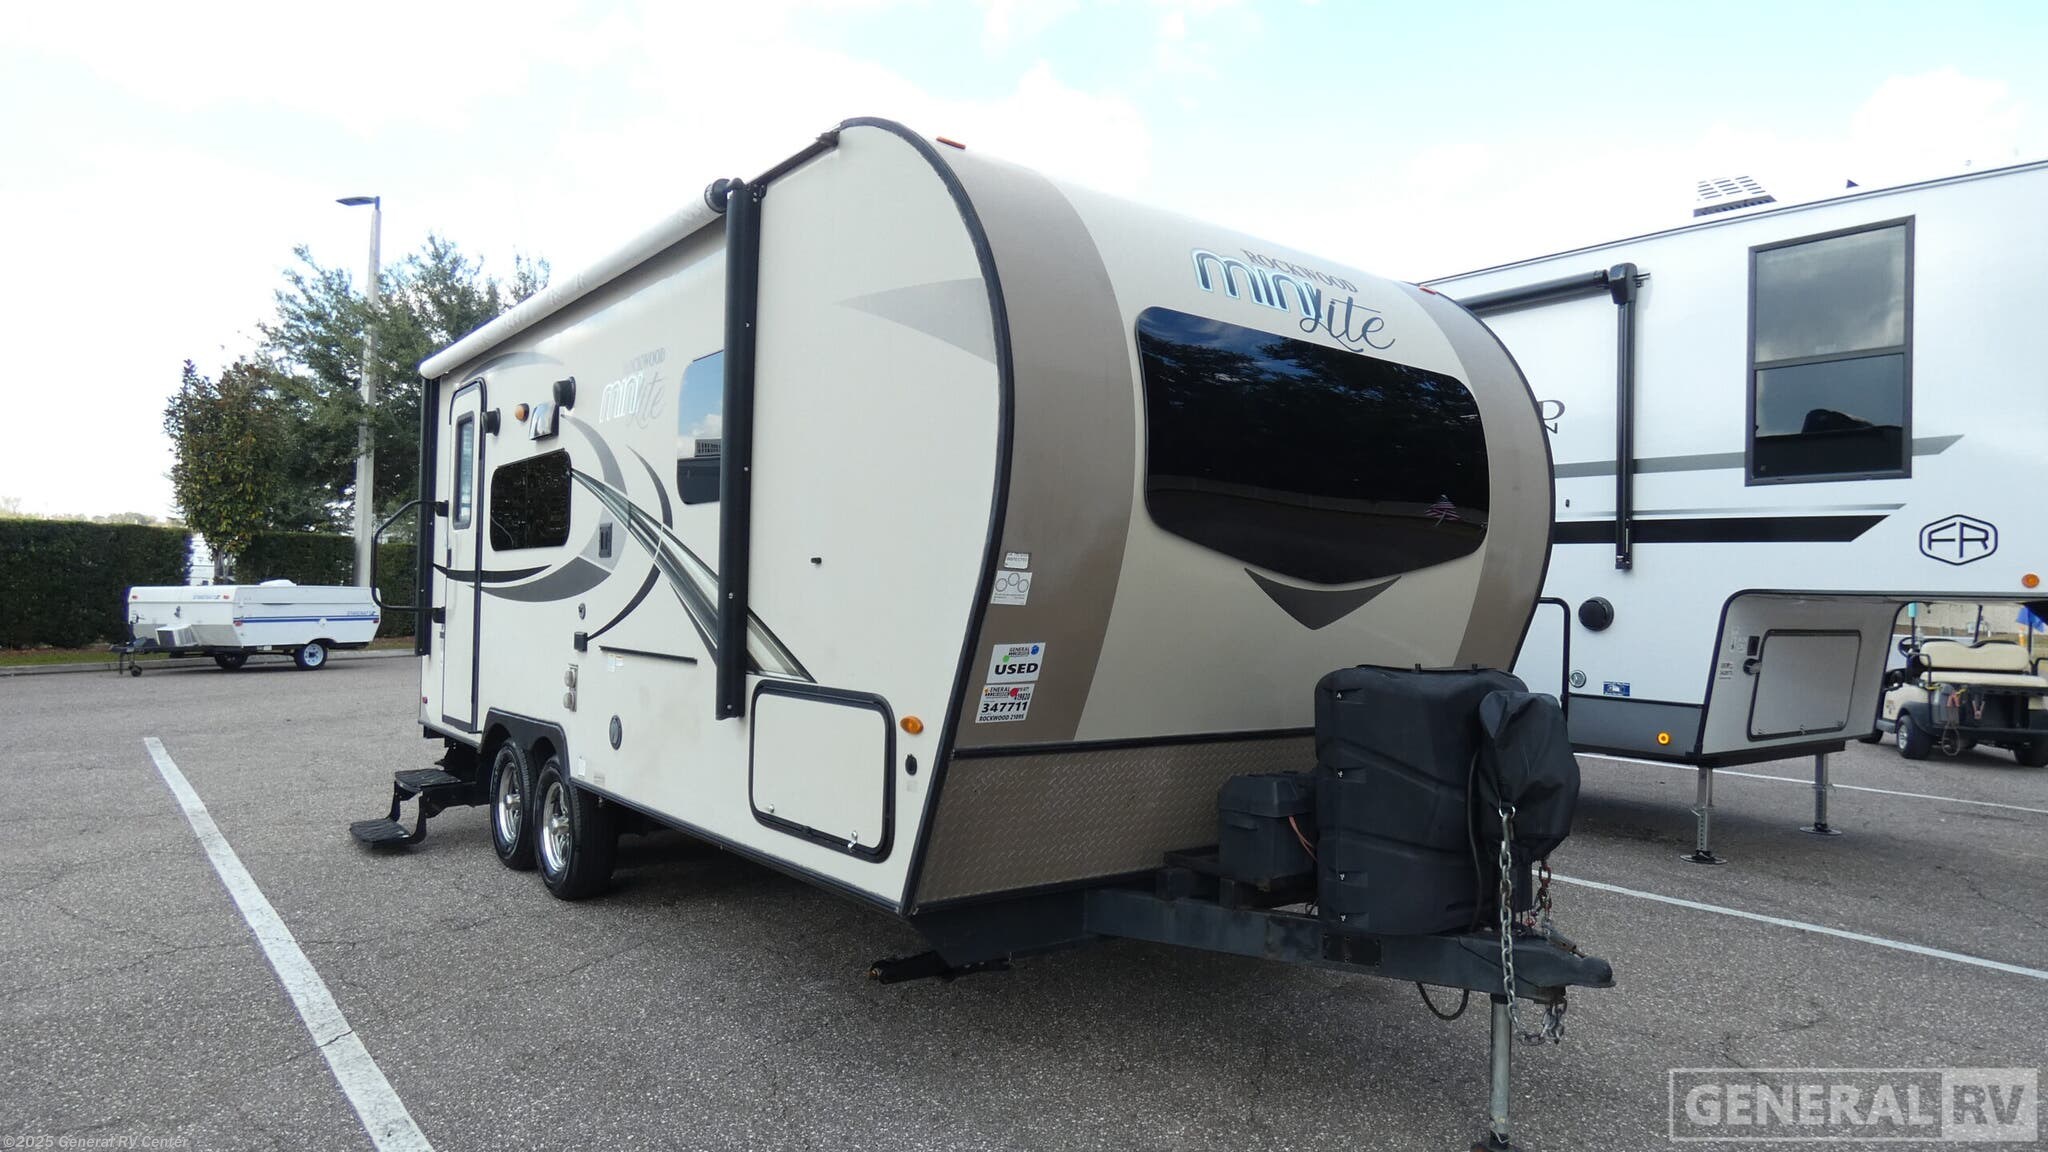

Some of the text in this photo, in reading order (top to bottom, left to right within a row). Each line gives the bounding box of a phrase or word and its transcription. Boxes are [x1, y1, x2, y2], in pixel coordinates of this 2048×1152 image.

[1241, 249, 1359, 293] ROCKWOOD
[995, 663, 1038, 675] USED
[982, 701, 1028, 713] 347711
